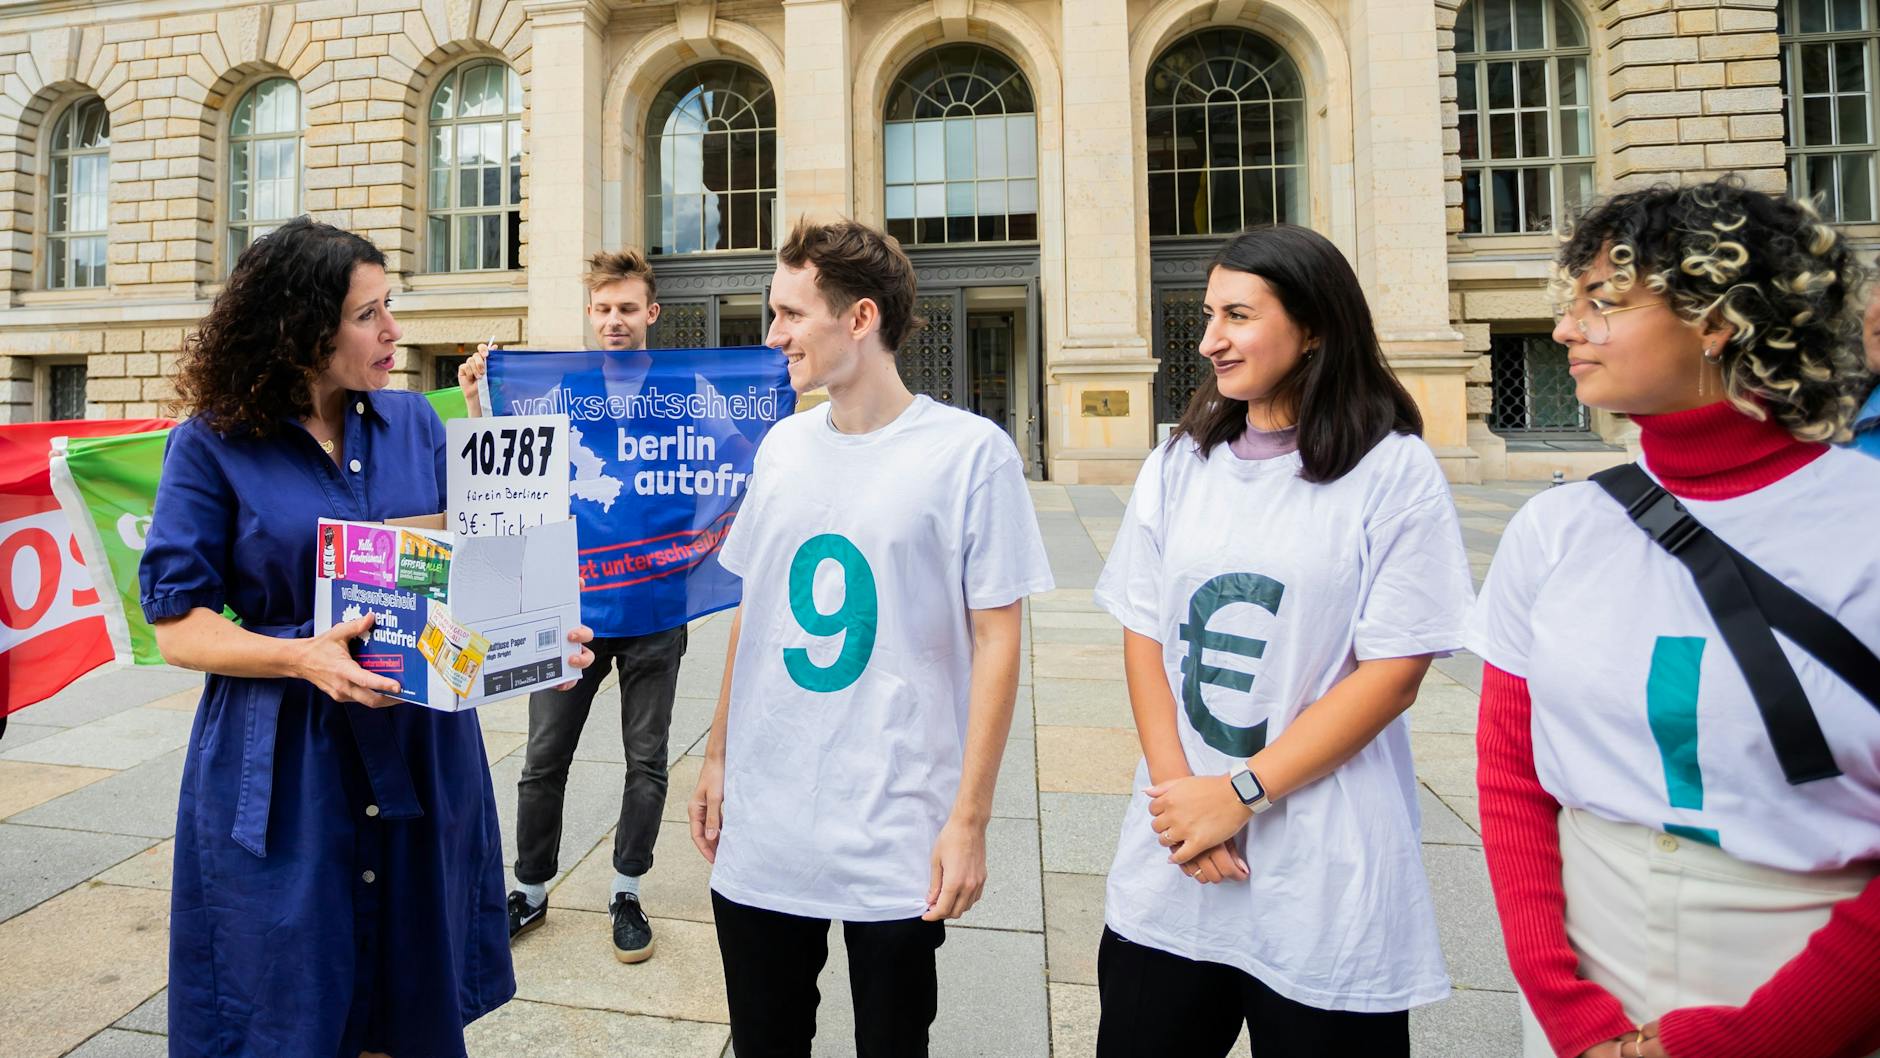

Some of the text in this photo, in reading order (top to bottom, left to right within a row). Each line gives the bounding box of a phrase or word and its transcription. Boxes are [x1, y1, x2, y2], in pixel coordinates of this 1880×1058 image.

[512, 386, 778, 421] volksentscheid
[461, 426, 555, 476] 10.787
[617, 426, 715, 461] berlin
[505, 487, 549, 500] Berliner
[783, 533, 878, 693] 9
[373, 627, 417, 649] autofrei
[510, 637, 526, 648] Paper
[1179, 572, 1285, 758] €
